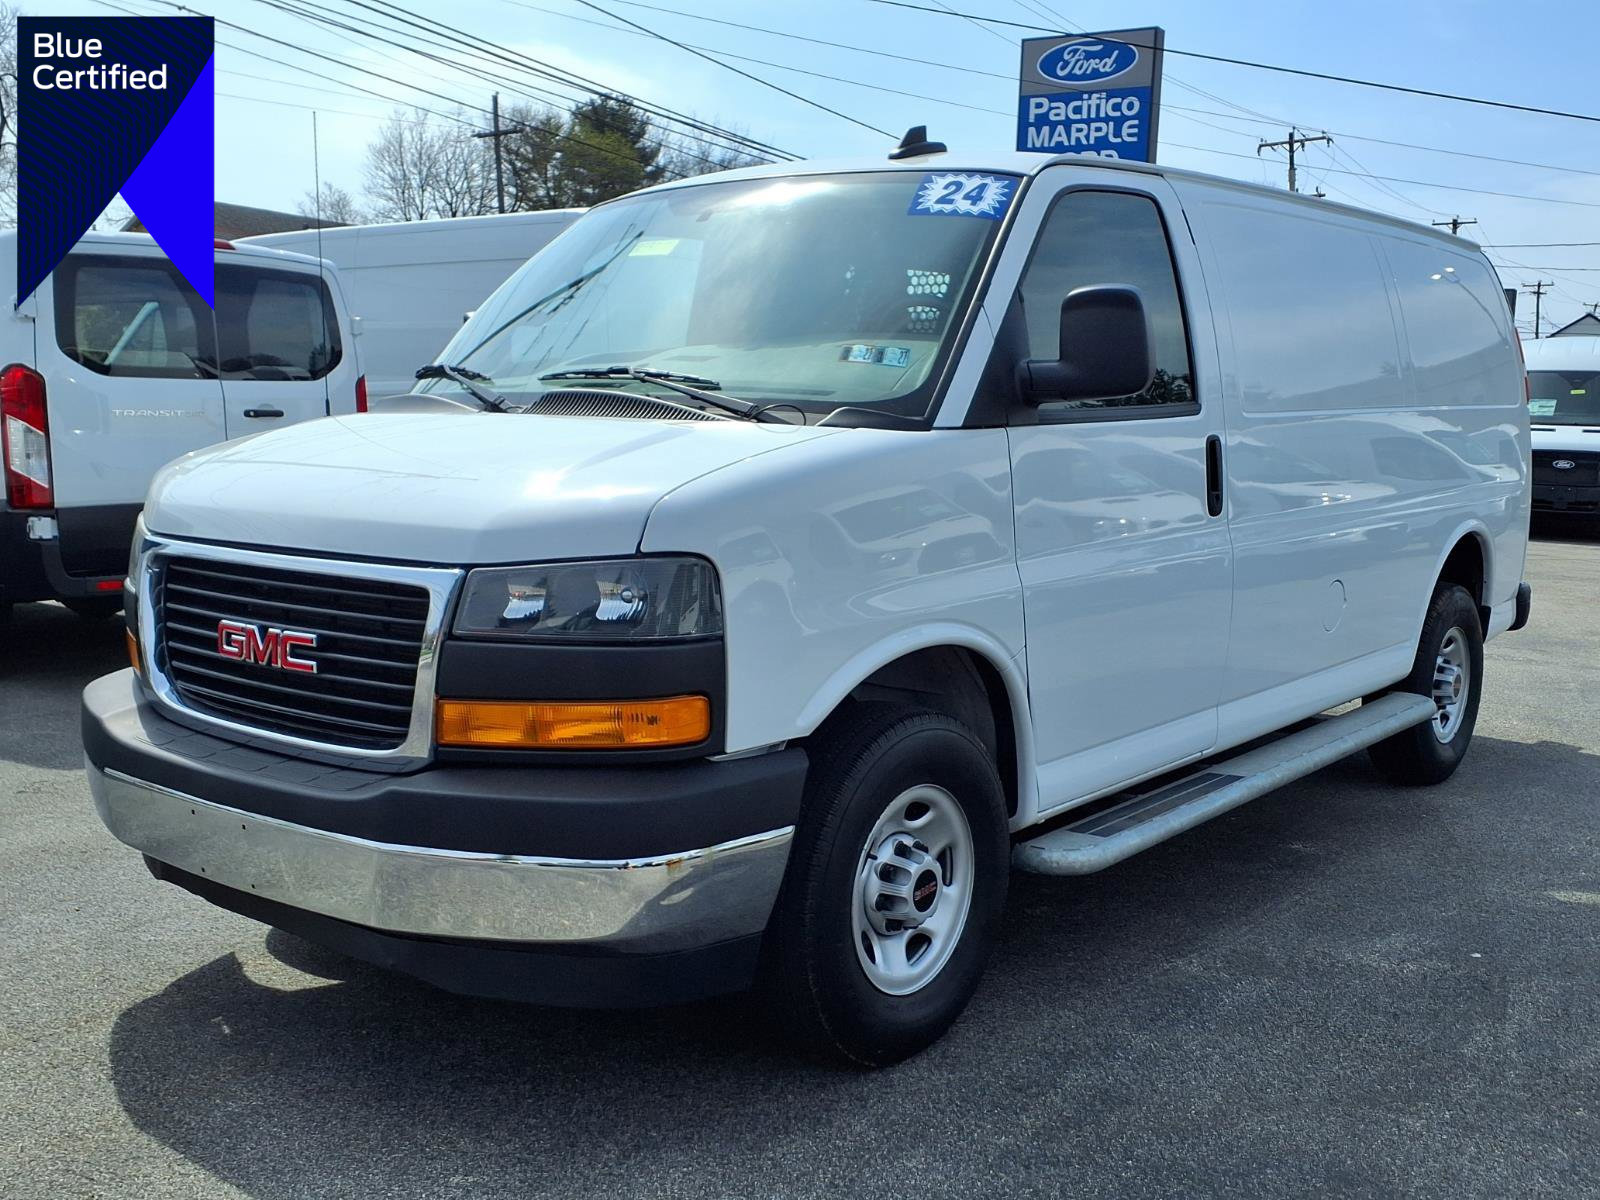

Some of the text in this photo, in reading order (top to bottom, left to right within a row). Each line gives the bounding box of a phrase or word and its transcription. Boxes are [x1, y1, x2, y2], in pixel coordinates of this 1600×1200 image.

[1056, 45, 1119, 76] Ford
[1028, 92, 1140, 123] Pacifico
[1026, 119, 1139, 148] MARPLE
[933, 180, 990, 206] 24
[111, 409, 185, 417] TRANSIT
[217, 619, 318, 674] GMC
